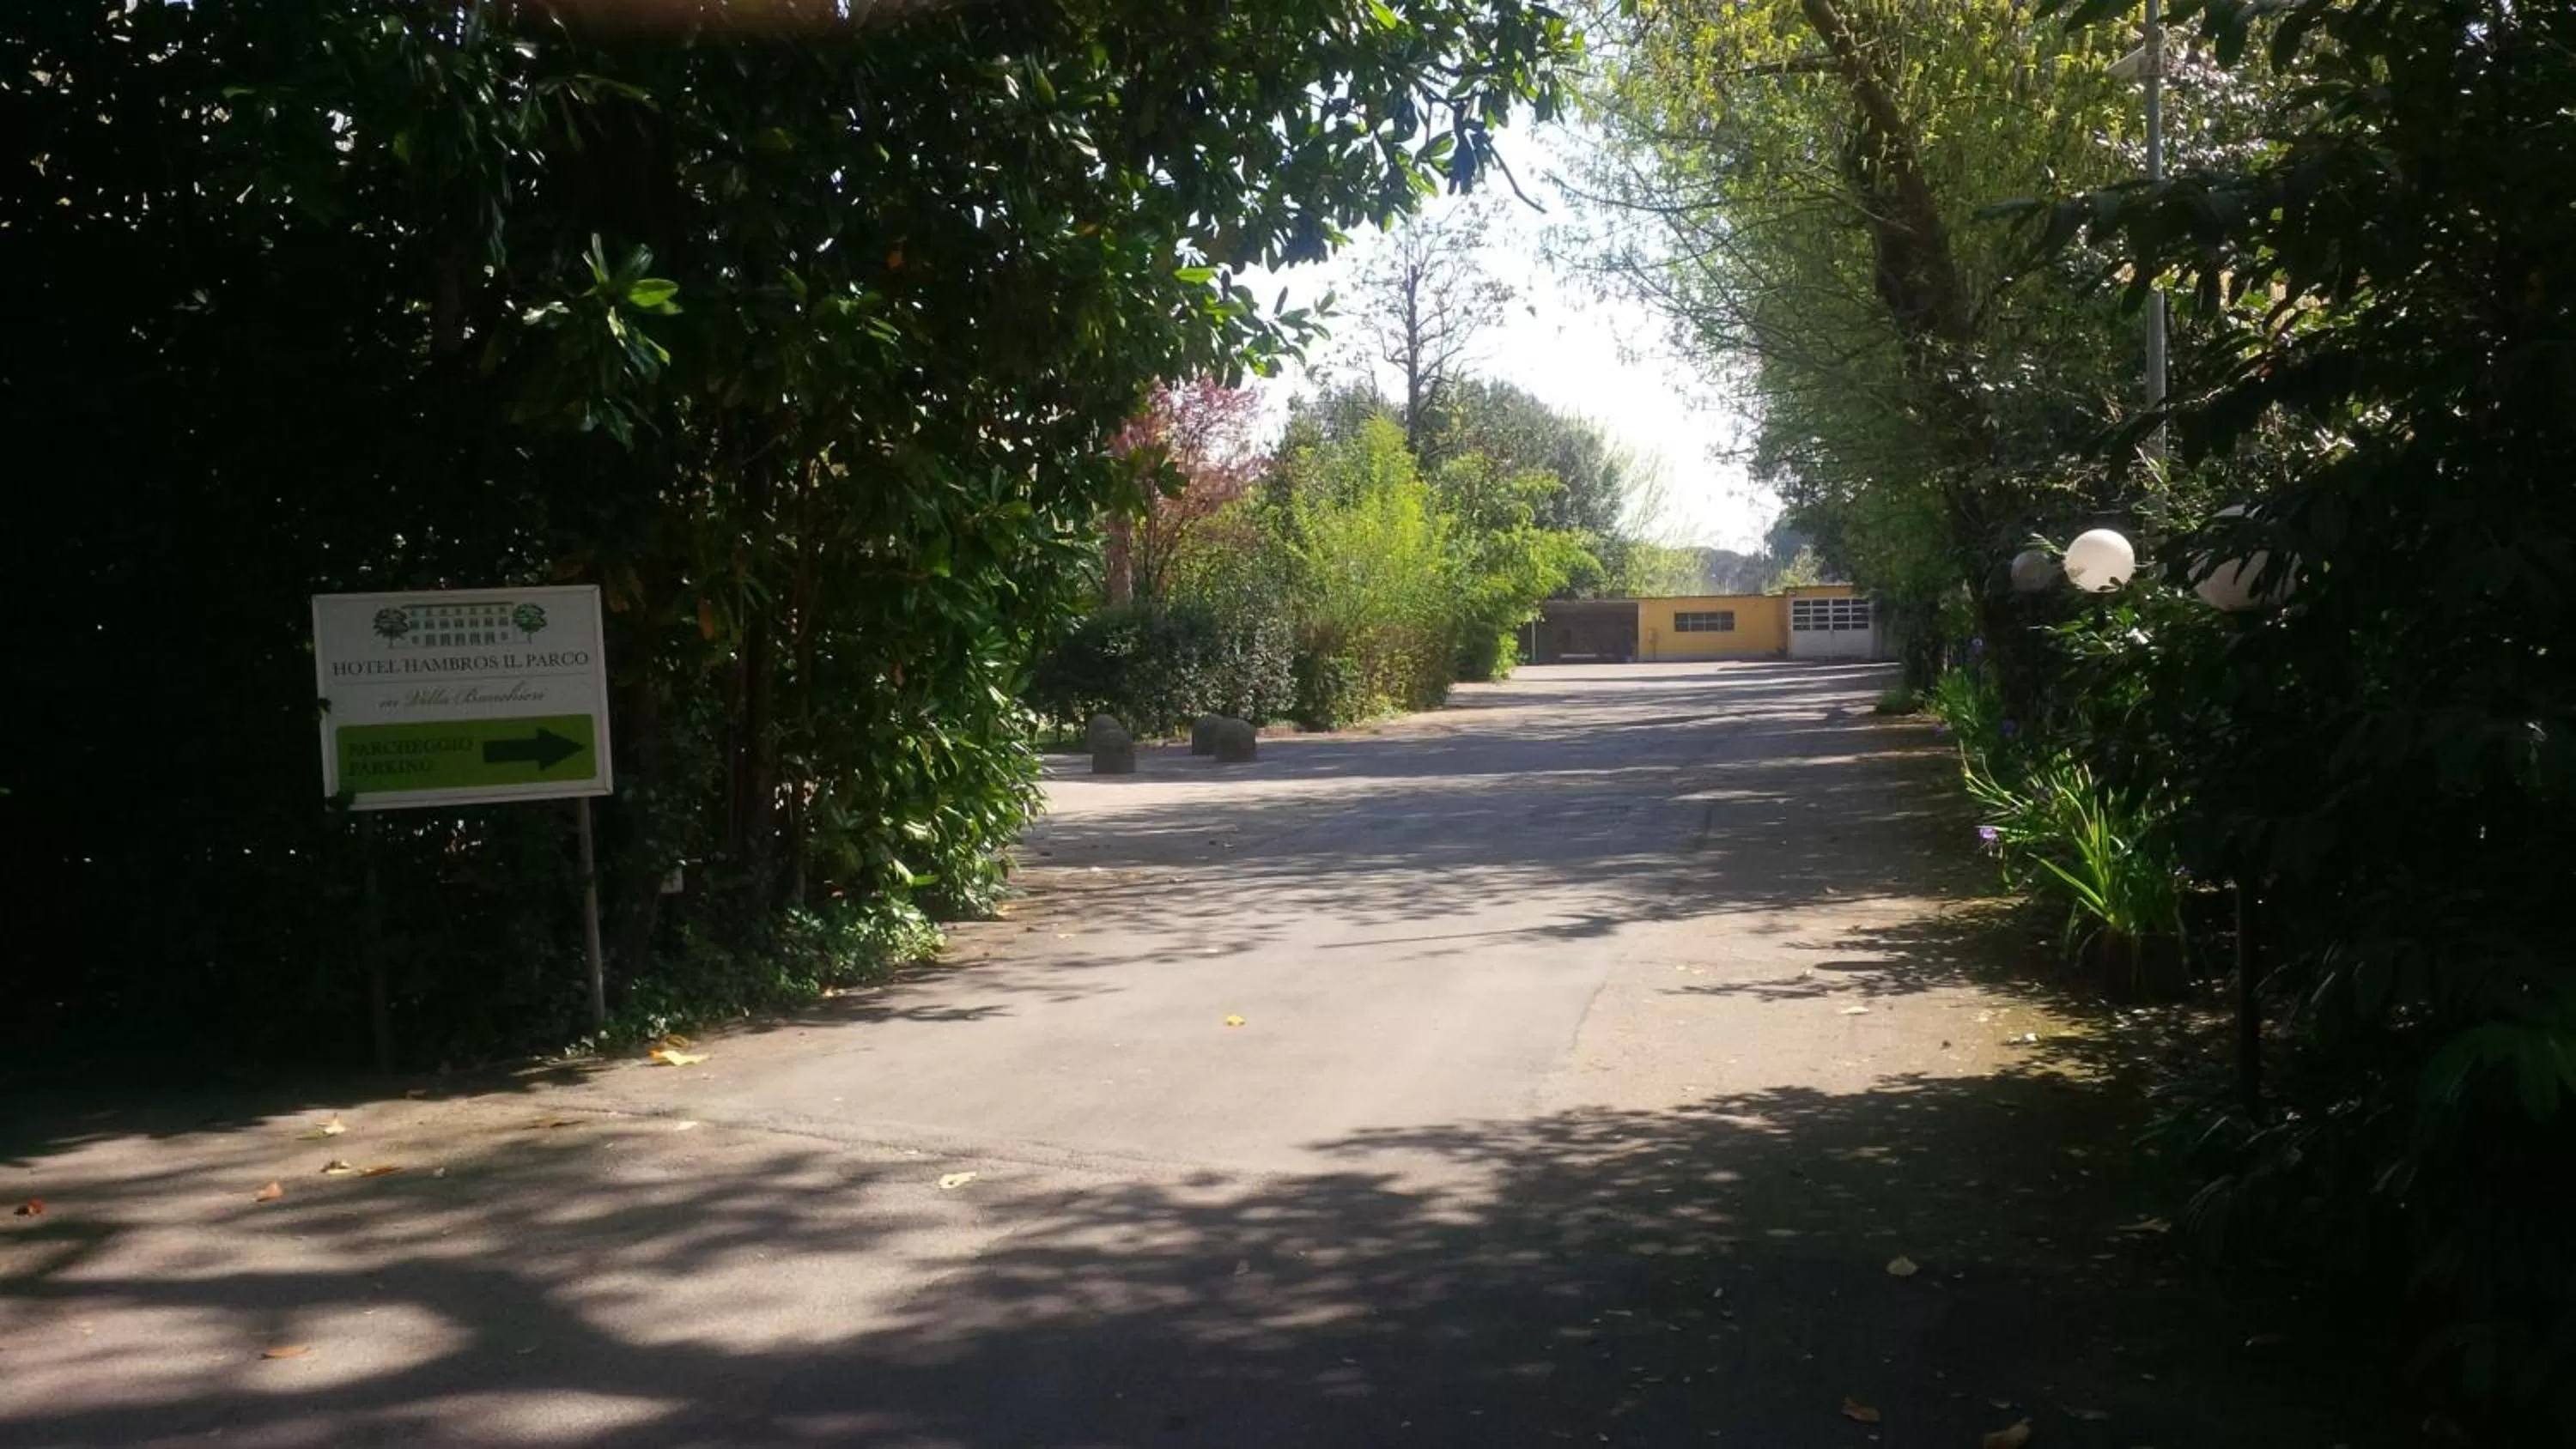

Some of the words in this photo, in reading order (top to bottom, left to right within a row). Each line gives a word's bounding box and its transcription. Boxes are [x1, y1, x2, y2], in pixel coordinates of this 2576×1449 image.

[332, 659, 400, 676] HOTEL
[403, 656, 498, 673] HAMBROS
[502, 655, 522, 669] IL
[526, 652, 589, 667] PARCO
[404, 687, 450, 707] Villa
[348, 738, 473, 756] PARCHEGGIO
[348, 759, 434, 777] PARKING
